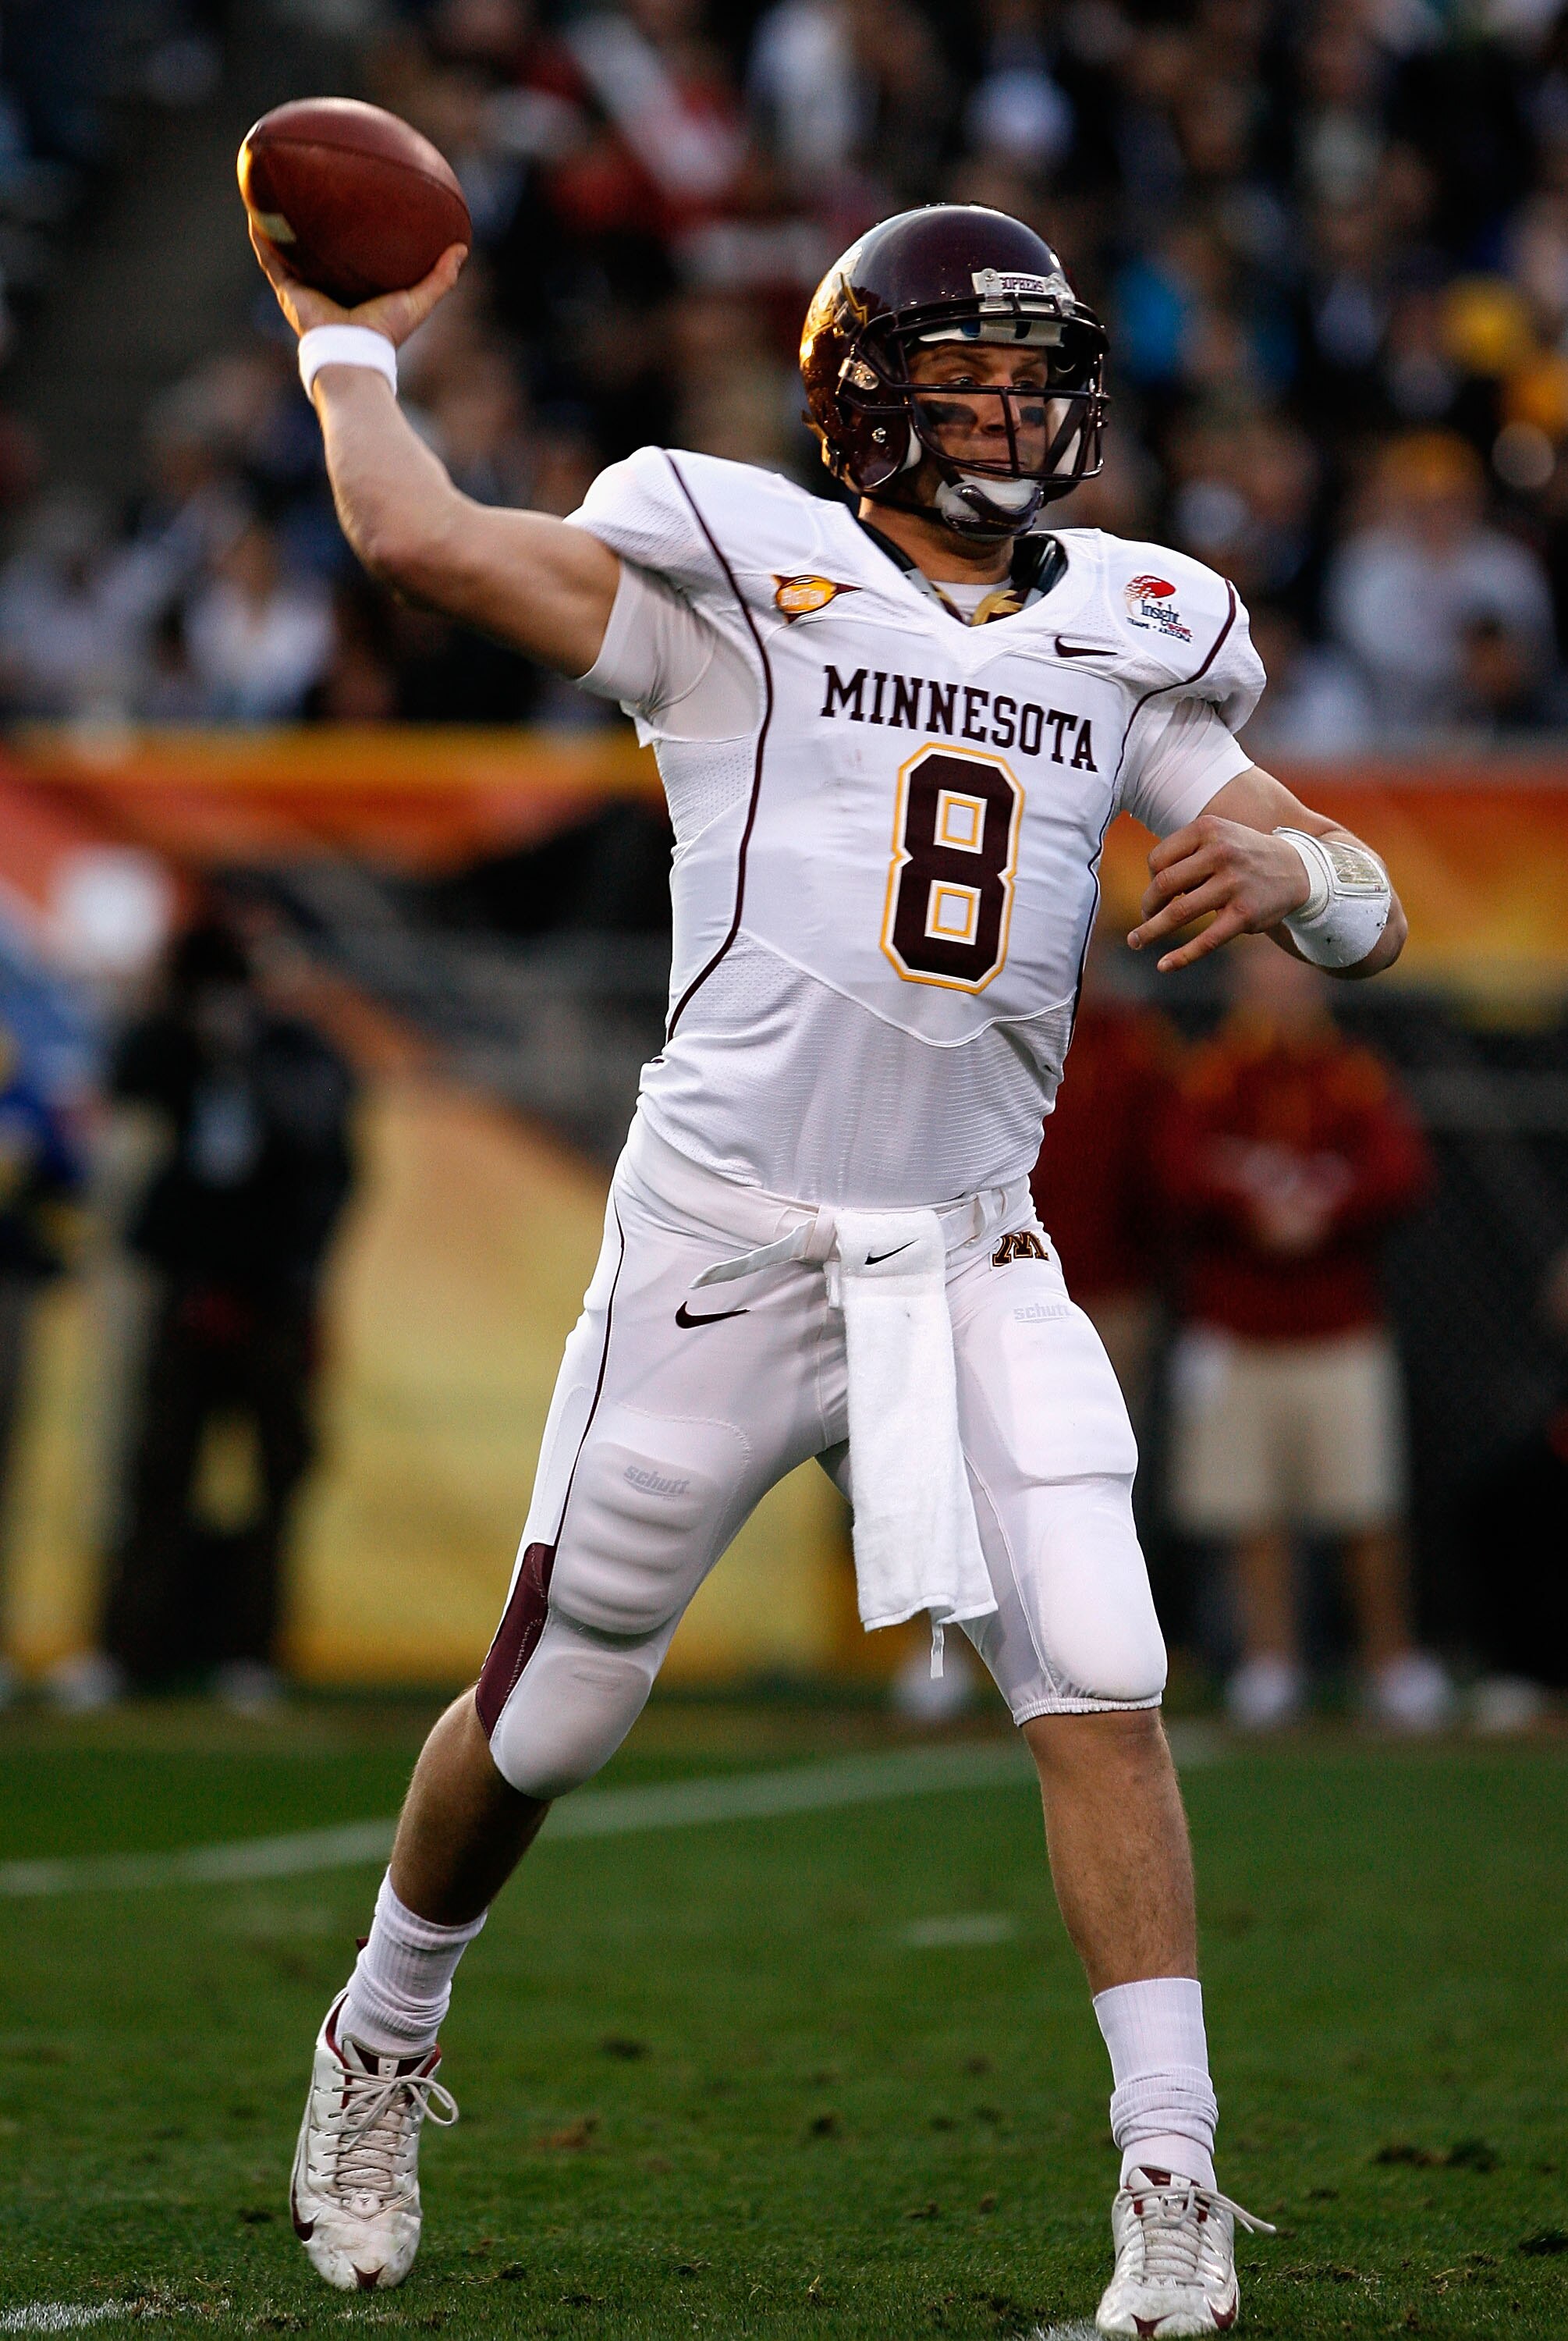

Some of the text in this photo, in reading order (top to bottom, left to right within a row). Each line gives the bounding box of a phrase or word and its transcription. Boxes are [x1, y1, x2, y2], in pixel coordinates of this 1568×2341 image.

[1141, 599, 1183, 626] Insight
[820, 665, 1098, 773] MINNESOTA
[880, 741, 1025, 995] 8
[992, 1231, 1050, 1266] M
[1014, 1302, 1073, 1321] schutt
[623, 1466, 690, 1494] schutt
